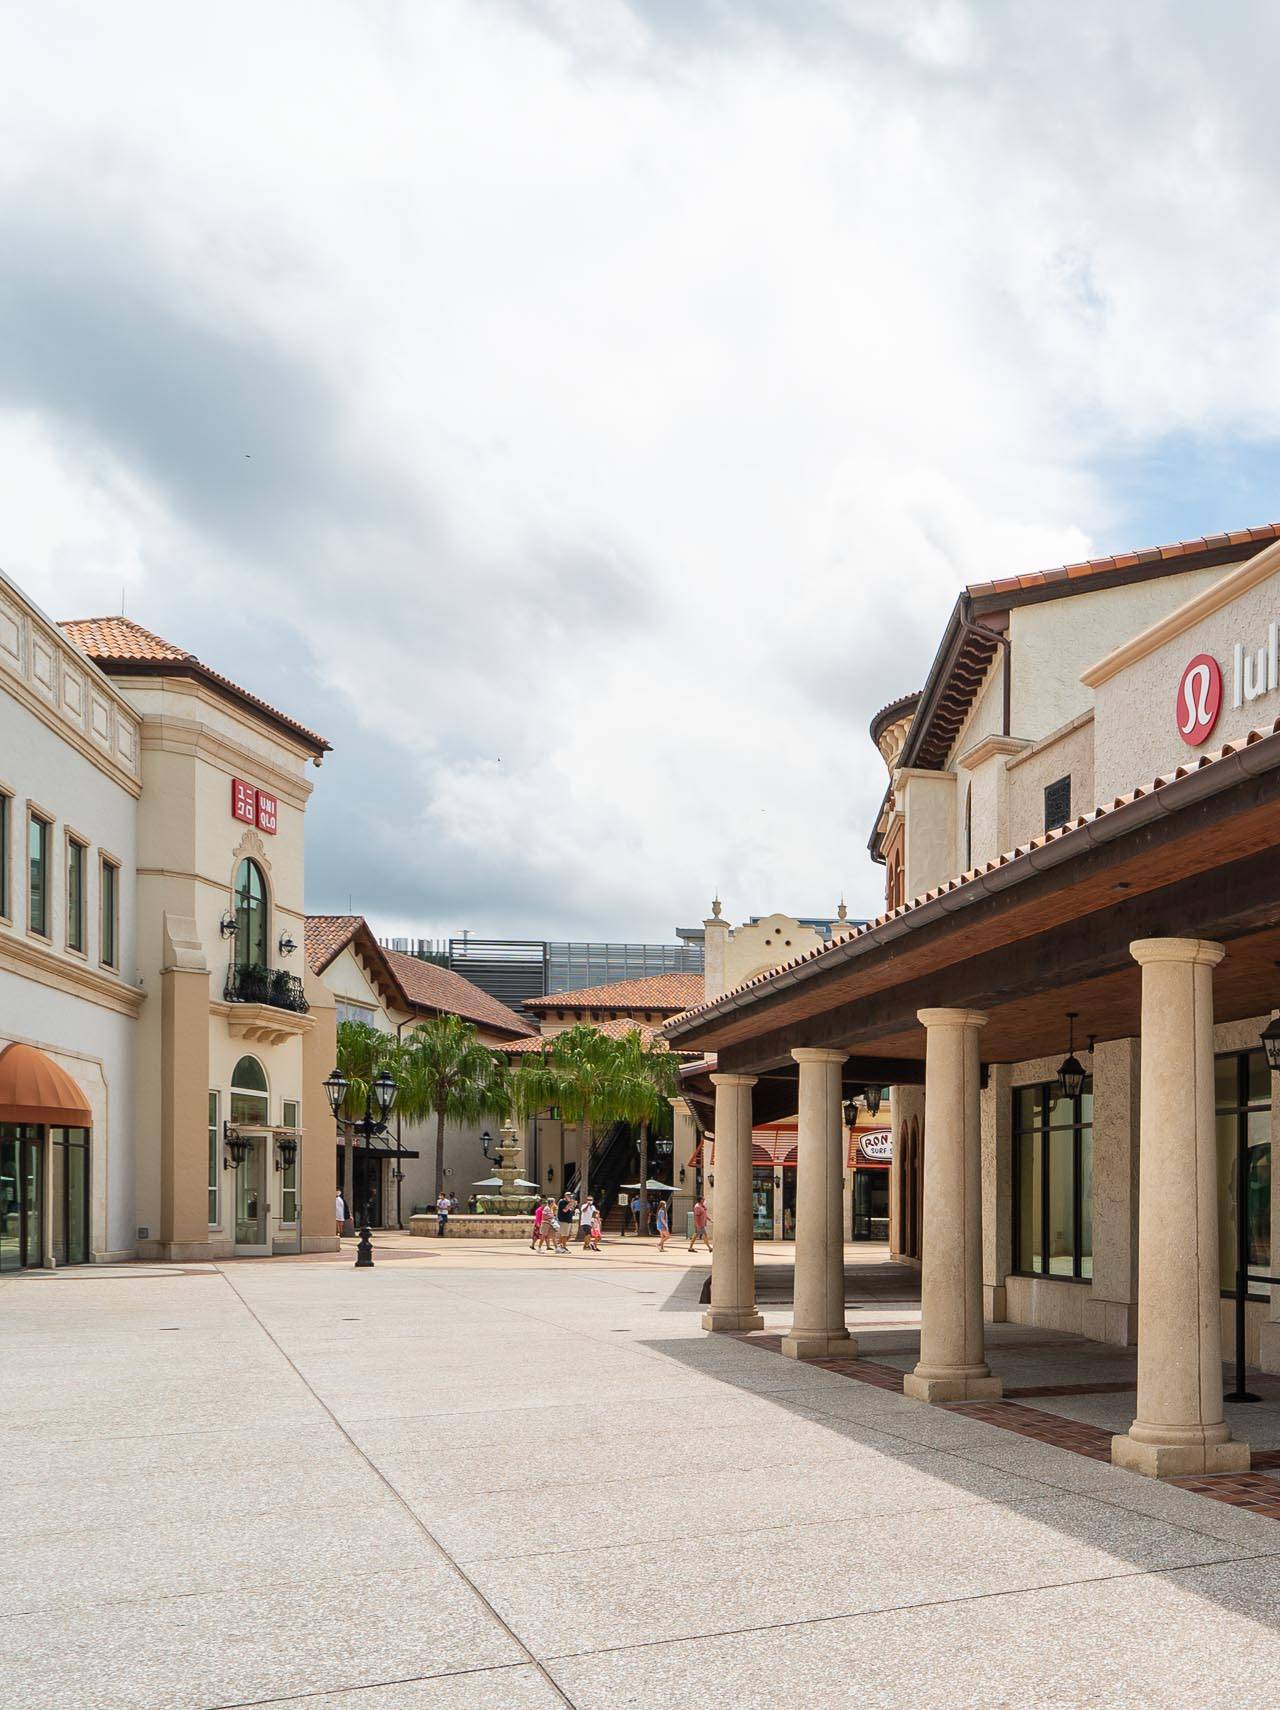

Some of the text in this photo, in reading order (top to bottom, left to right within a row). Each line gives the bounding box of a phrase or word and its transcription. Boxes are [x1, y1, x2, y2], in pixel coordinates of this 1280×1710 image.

[260, 796, 275, 814] UNI
[260, 812, 276, 829] QLO
[864, 1134, 889, 1149] RON
